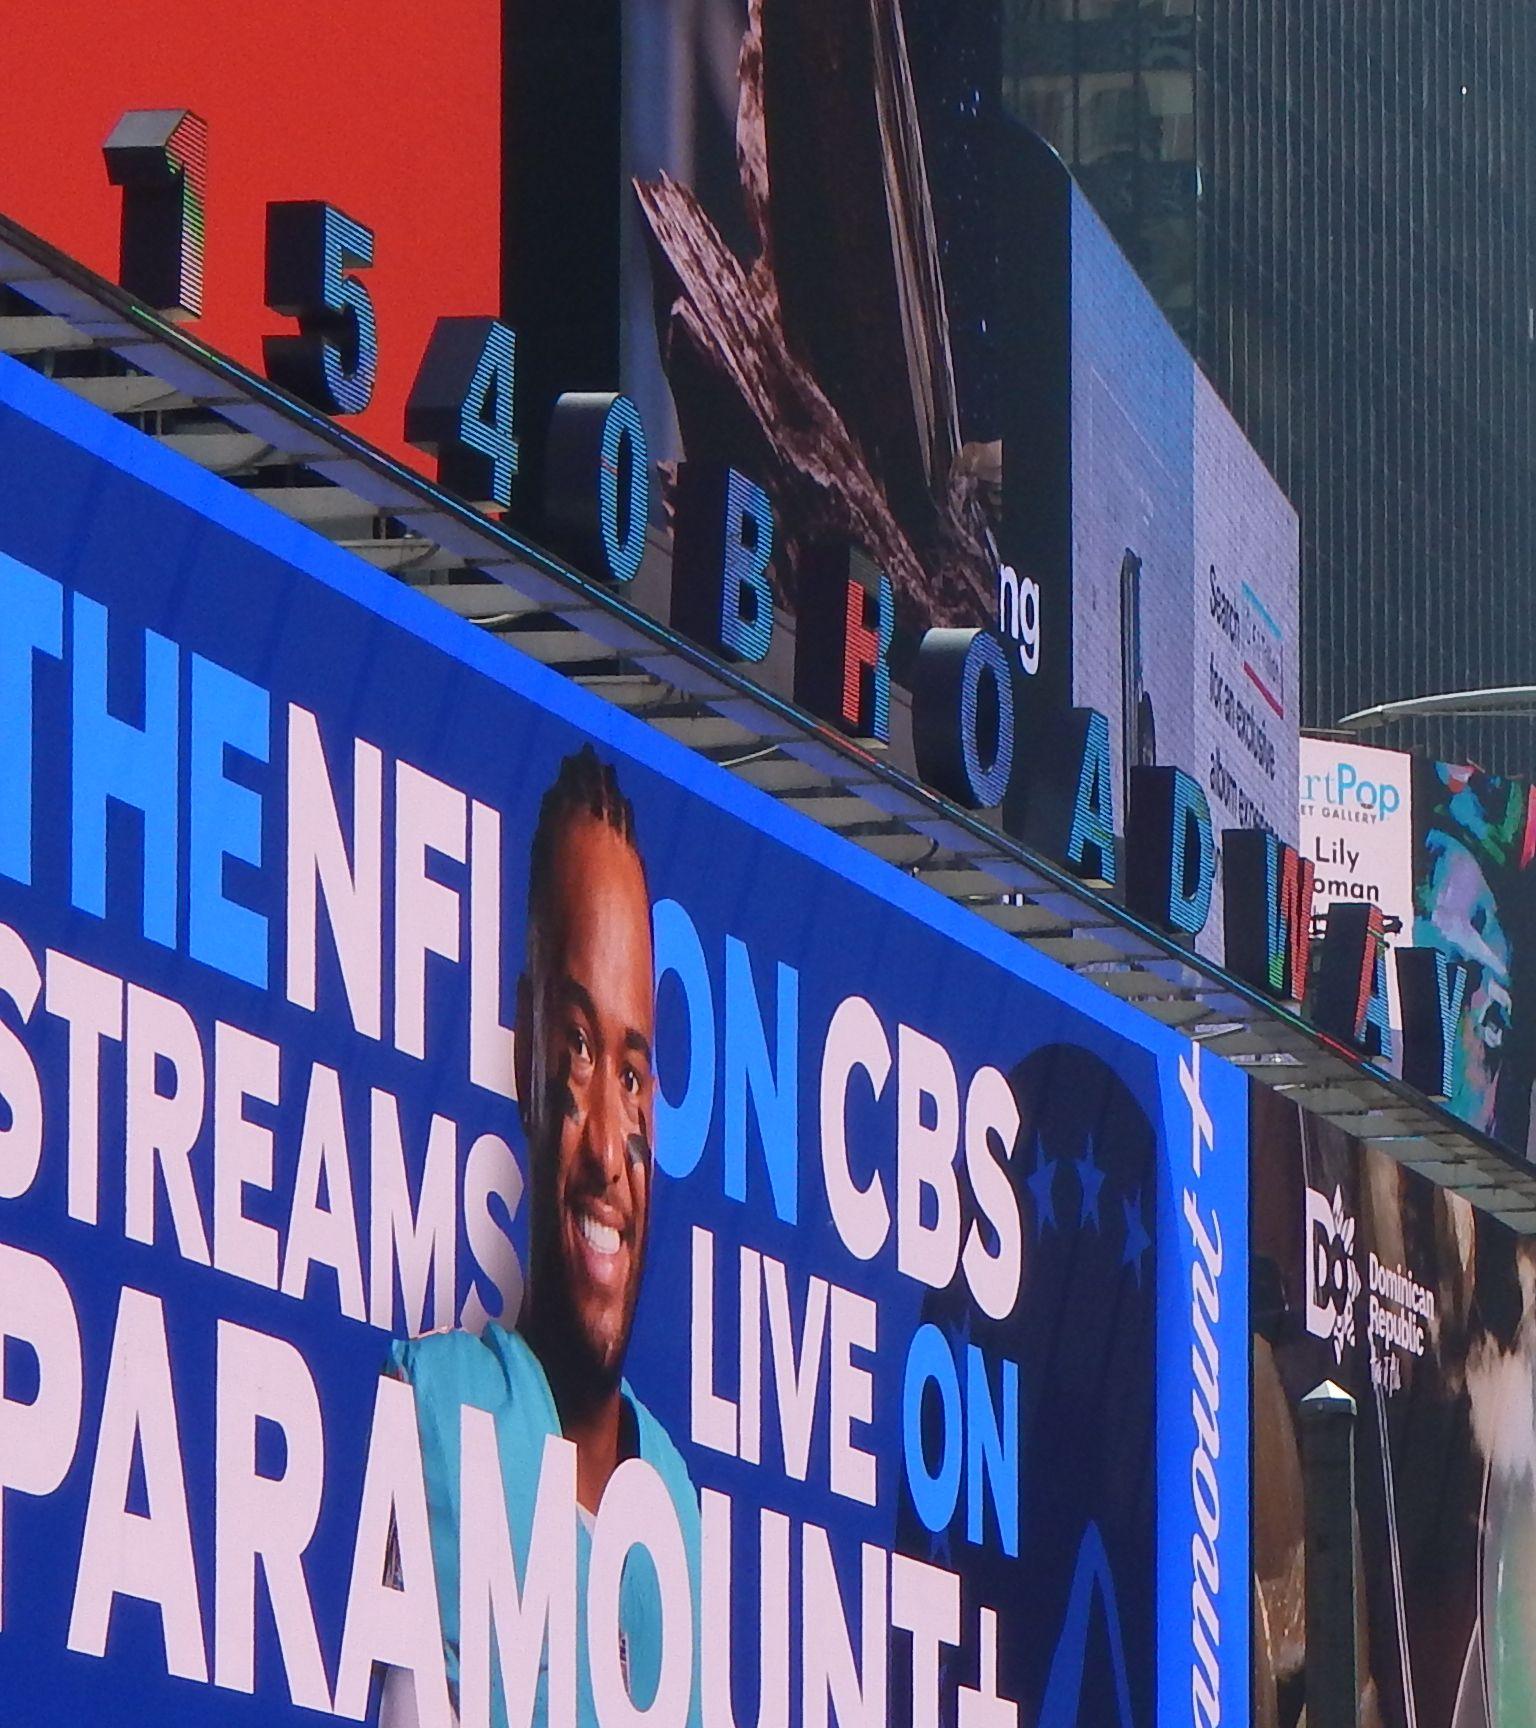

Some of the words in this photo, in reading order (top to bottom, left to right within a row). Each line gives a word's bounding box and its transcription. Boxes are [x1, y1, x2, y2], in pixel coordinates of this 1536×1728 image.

[104, 108, 652, 585] 1540
[672, 465, 1468, 1100] BROADWAY
[1301, 762, 1400, 819] rtPop
[1315, 835, 1361, 873] Lily
[1312, 876, 1380, 903] oman
[0, 551, 270, 990] THE
[286, 702, 518, 1098] NFL
[652, 897, 798, 1224] ON
[820, 995, 1022, 1320] CBS
[1369, 1251, 1436, 1322] Dominican
[1369, 1293, 1425, 1358] Republic
[690, 1226, 877, 1508] LIVE
[903, 1322, 1019, 1560] ON
